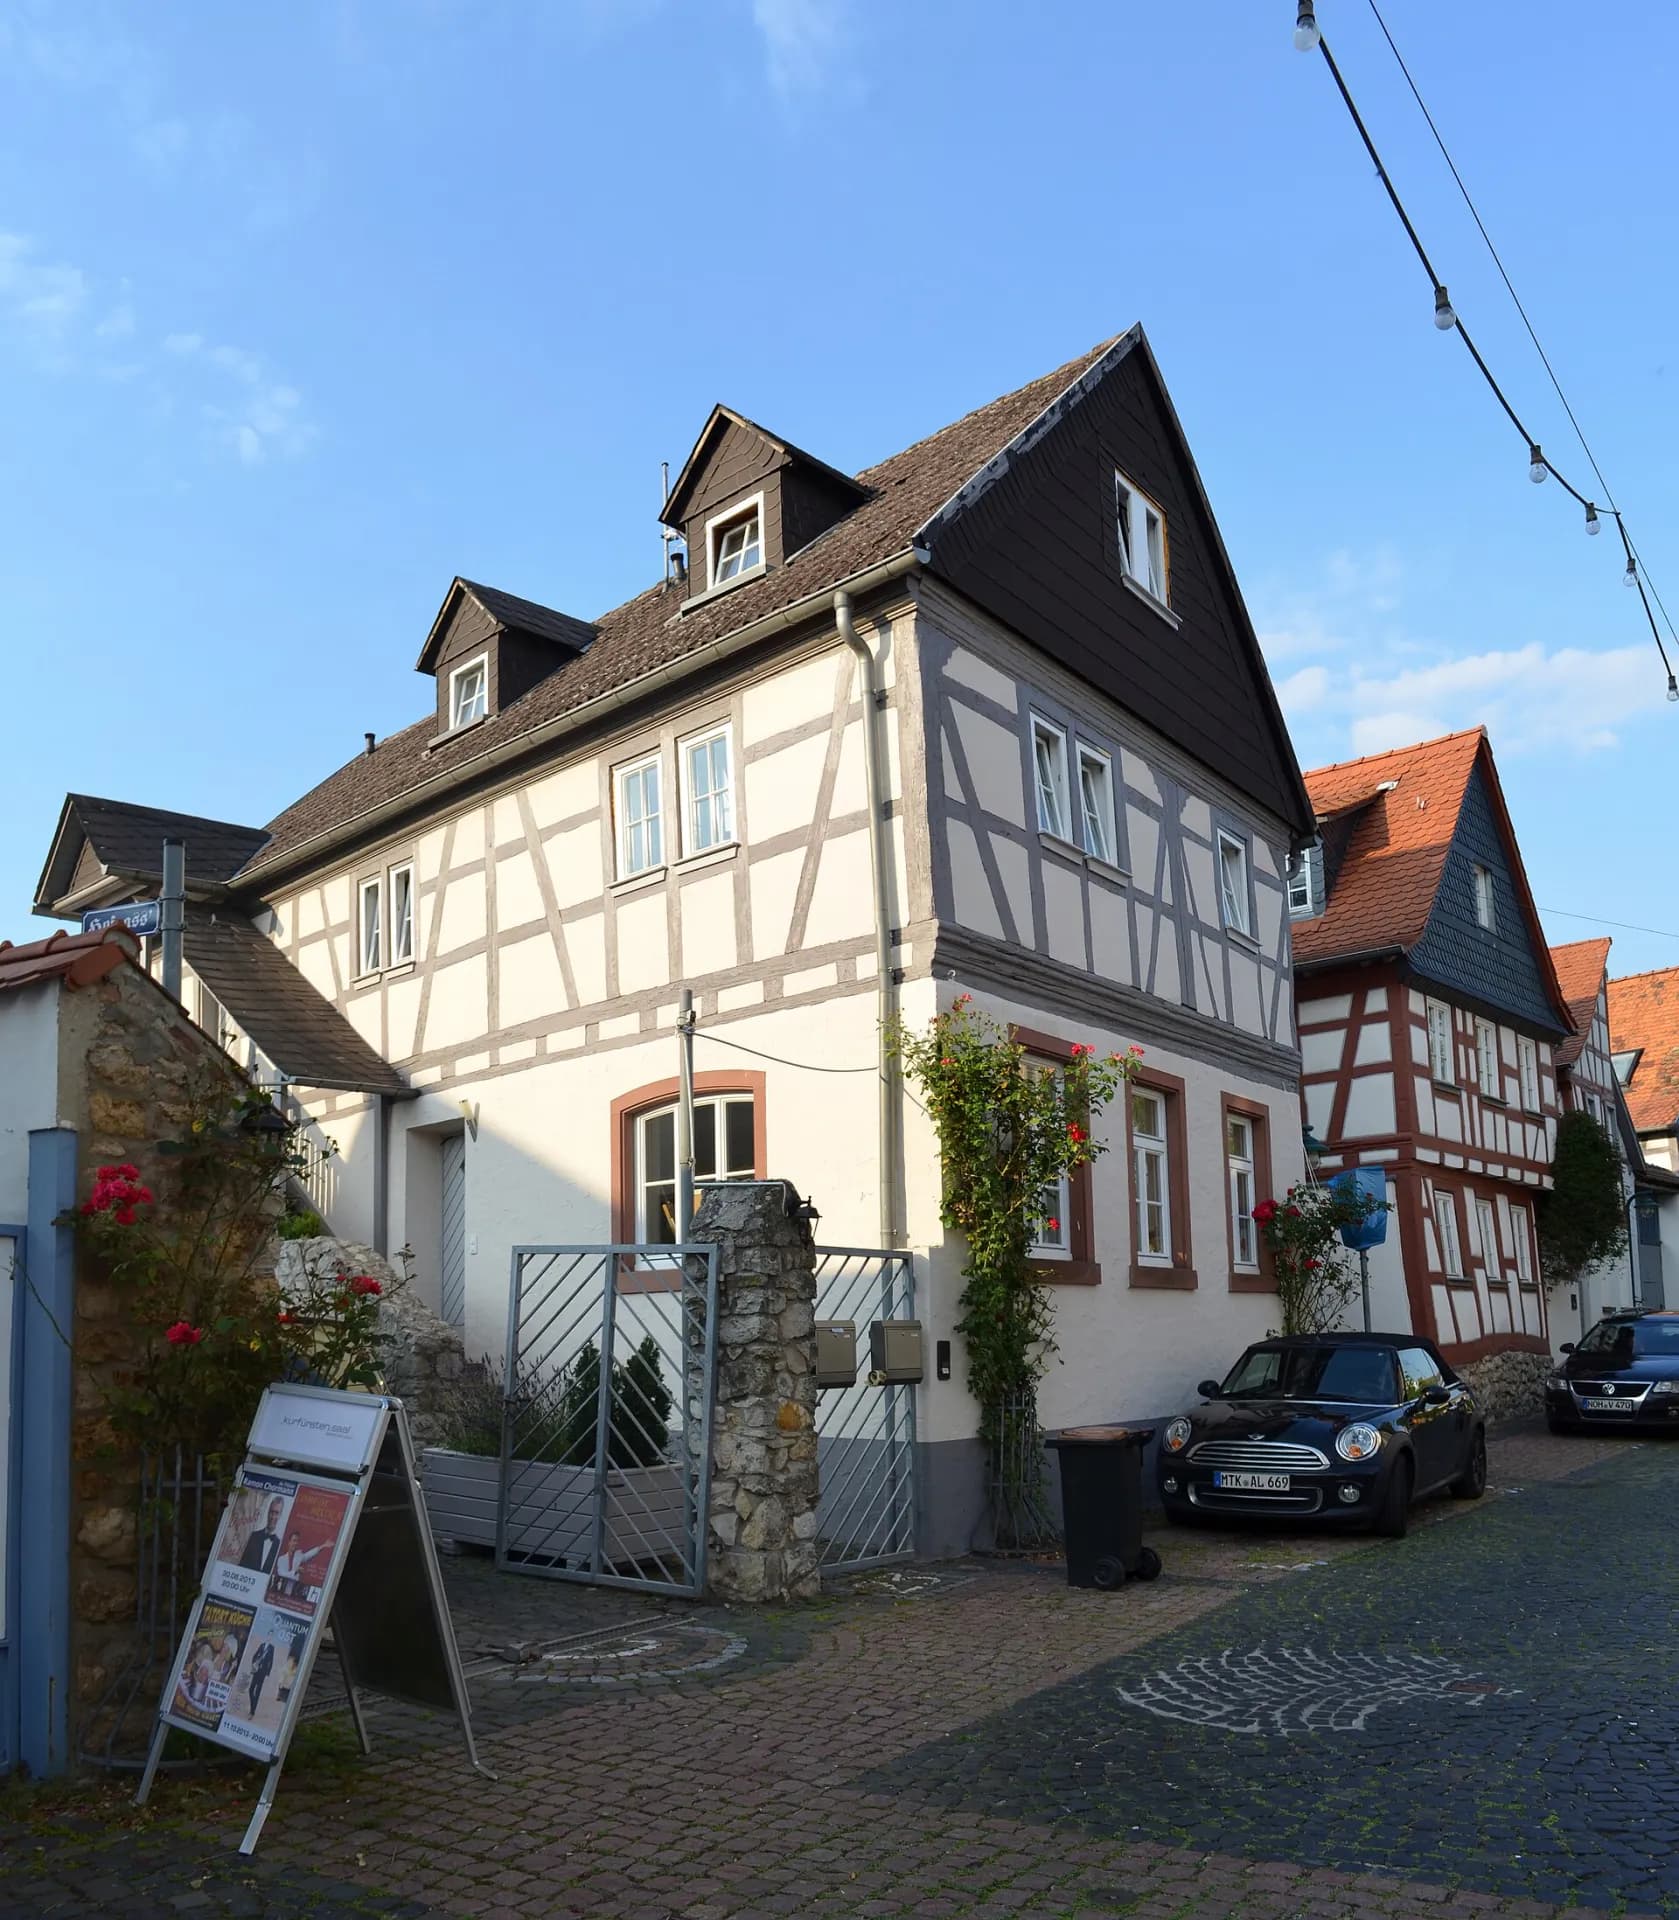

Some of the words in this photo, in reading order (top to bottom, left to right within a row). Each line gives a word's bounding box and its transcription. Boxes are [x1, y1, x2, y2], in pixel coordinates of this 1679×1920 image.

[1221, 1474, 1241, 1487] MTK
[1250, 1475, 1264, 1488] AL
[1267, 1476, 1289, 1489] 669
[273, 1614, 309, 1635] QUANTUM
